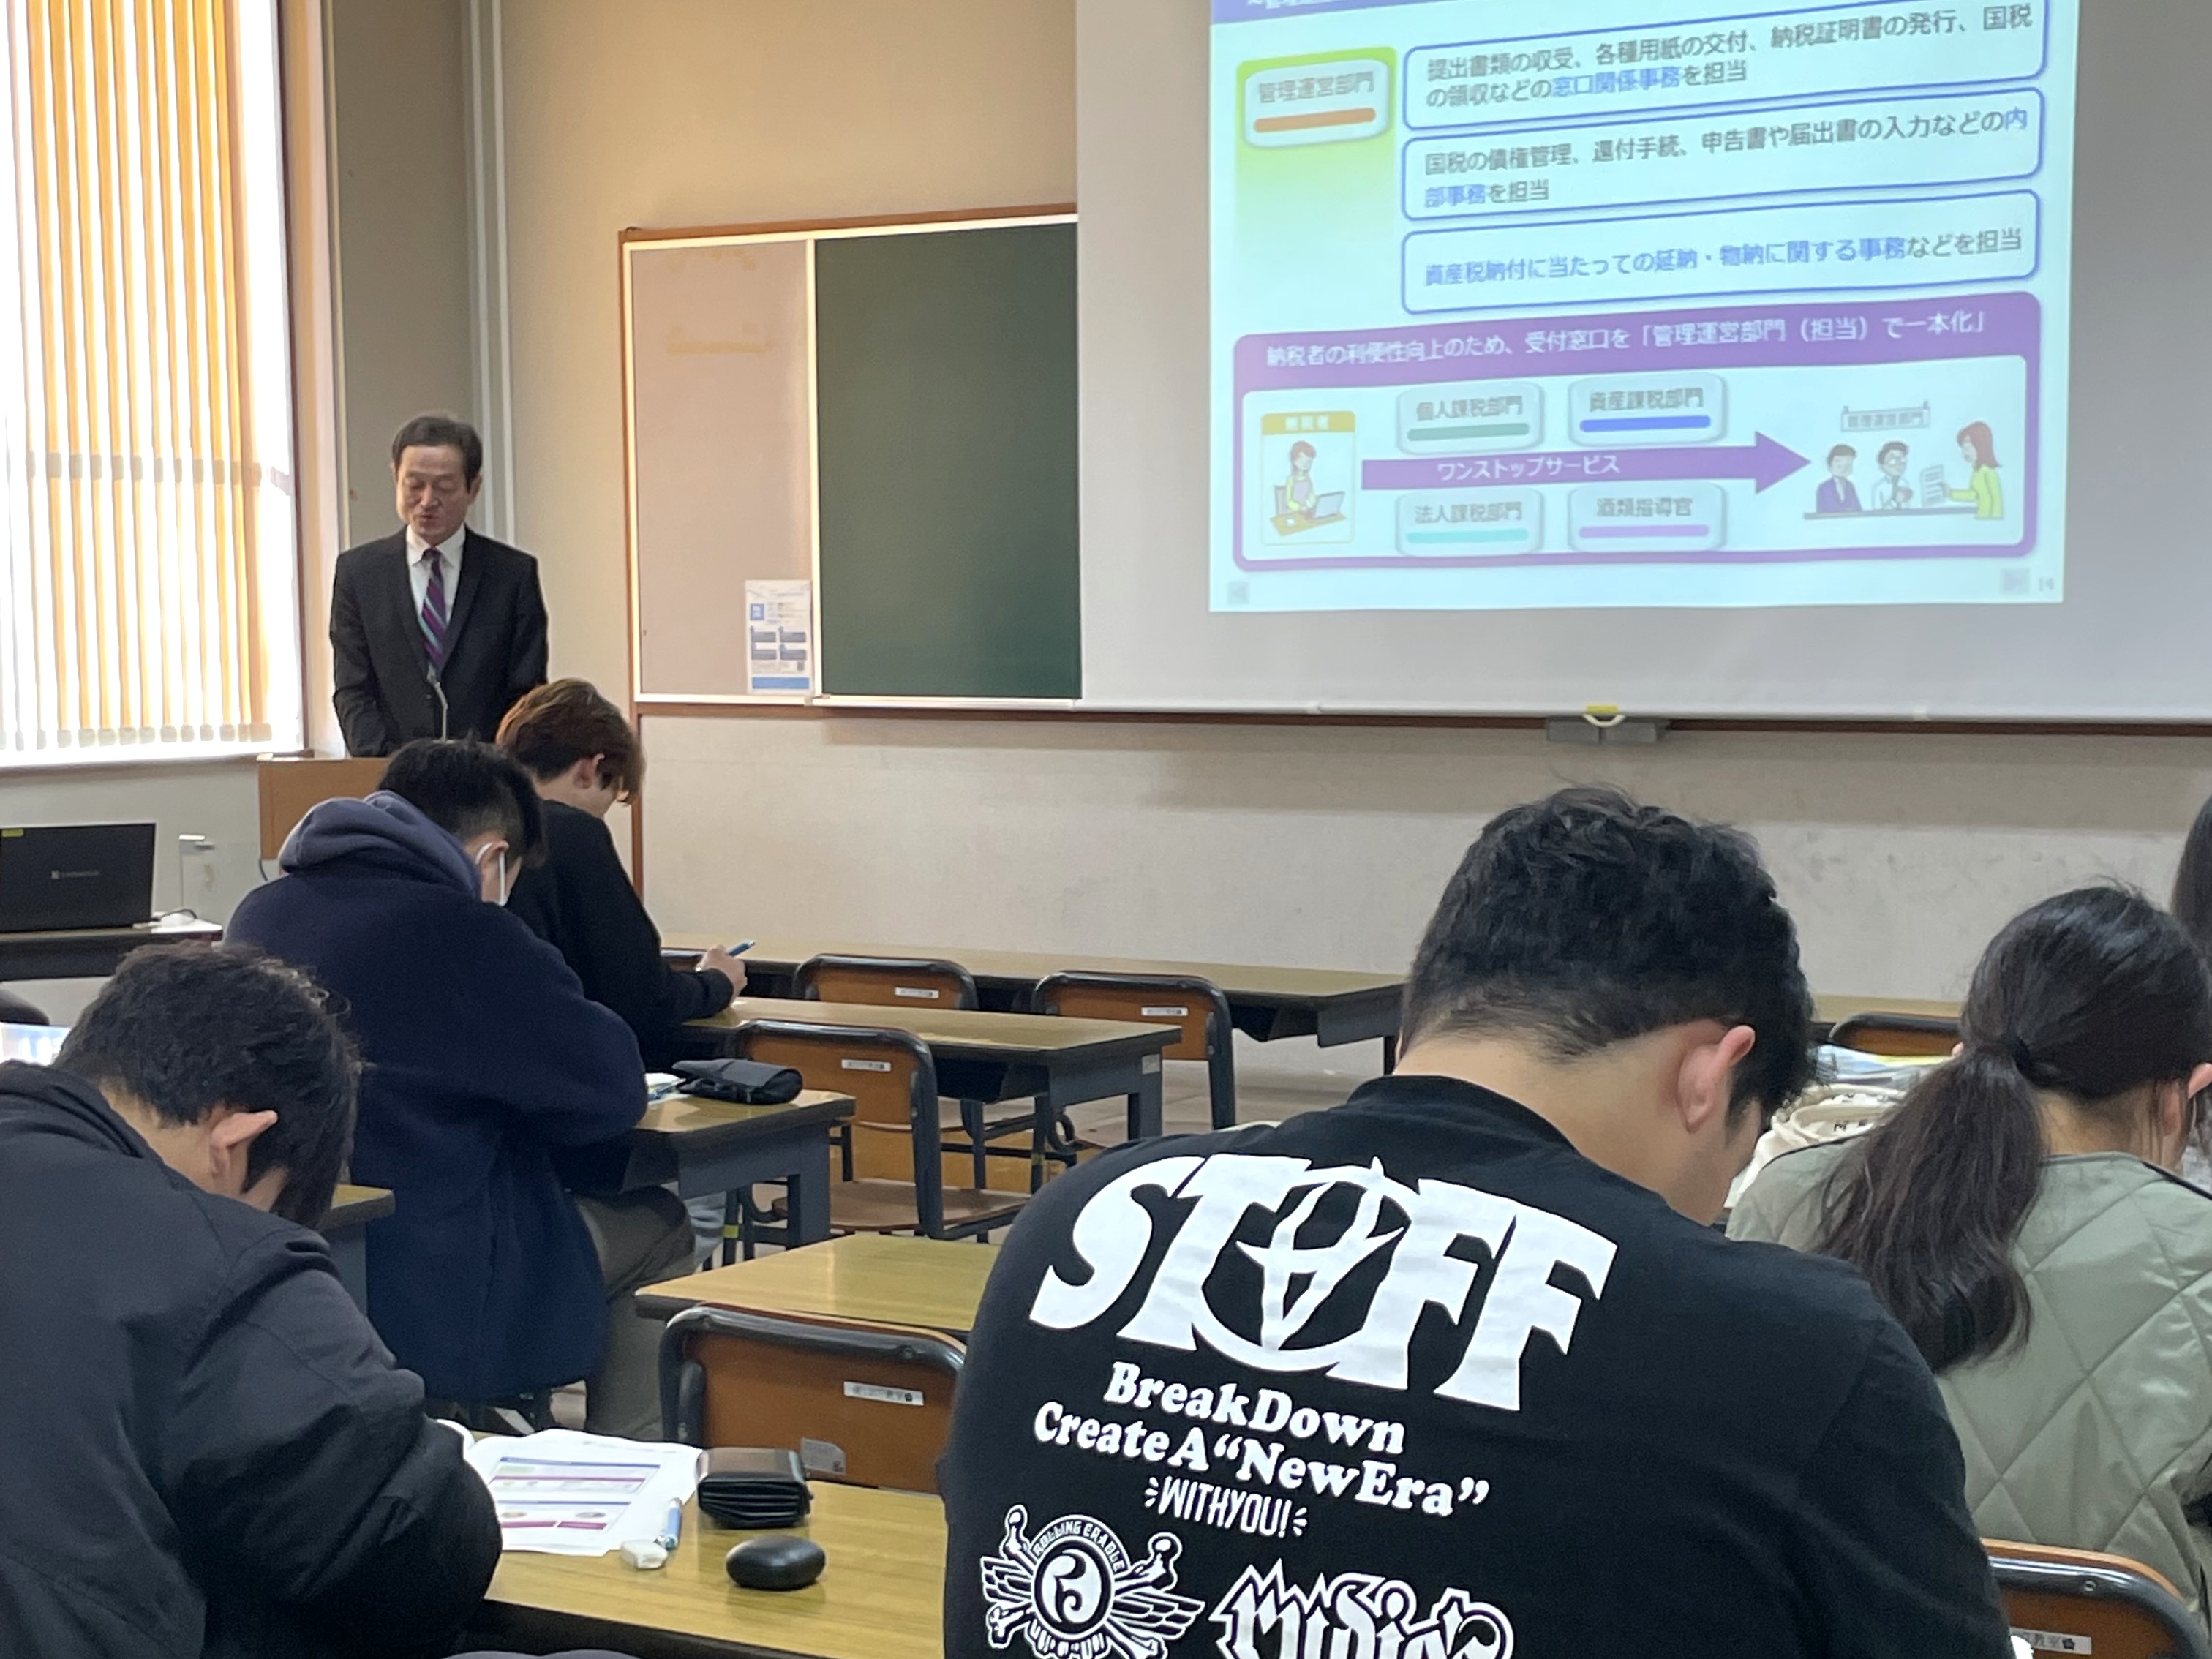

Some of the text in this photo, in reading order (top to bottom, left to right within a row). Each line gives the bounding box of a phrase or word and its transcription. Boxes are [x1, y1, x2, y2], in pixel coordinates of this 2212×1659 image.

[1259, 71, 1374, 103] 管理運営部門
[1437, 455, 1620, 481] ワンストップサービス
[1029, 1154, 1619, 1411] STAFF
